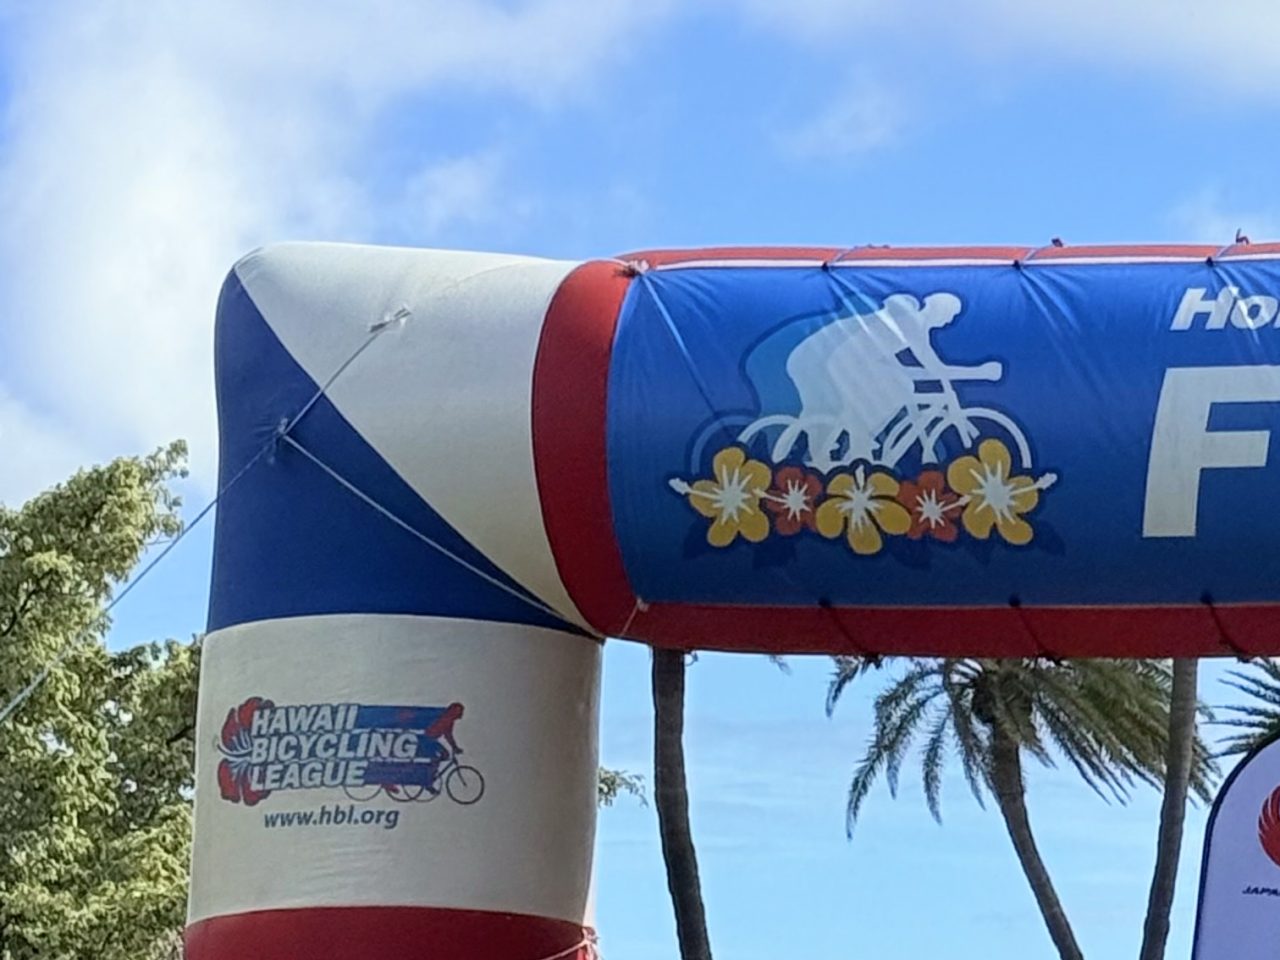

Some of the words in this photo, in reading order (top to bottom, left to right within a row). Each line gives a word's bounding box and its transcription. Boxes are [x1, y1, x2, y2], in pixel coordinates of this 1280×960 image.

[252, 704, 359, 736] HAWAII
[251, 732, 419, 764] BICYCLING
[251, 760, 368, 790] LEAGUE
[264, 804, 399, 829] www.hbl.org
